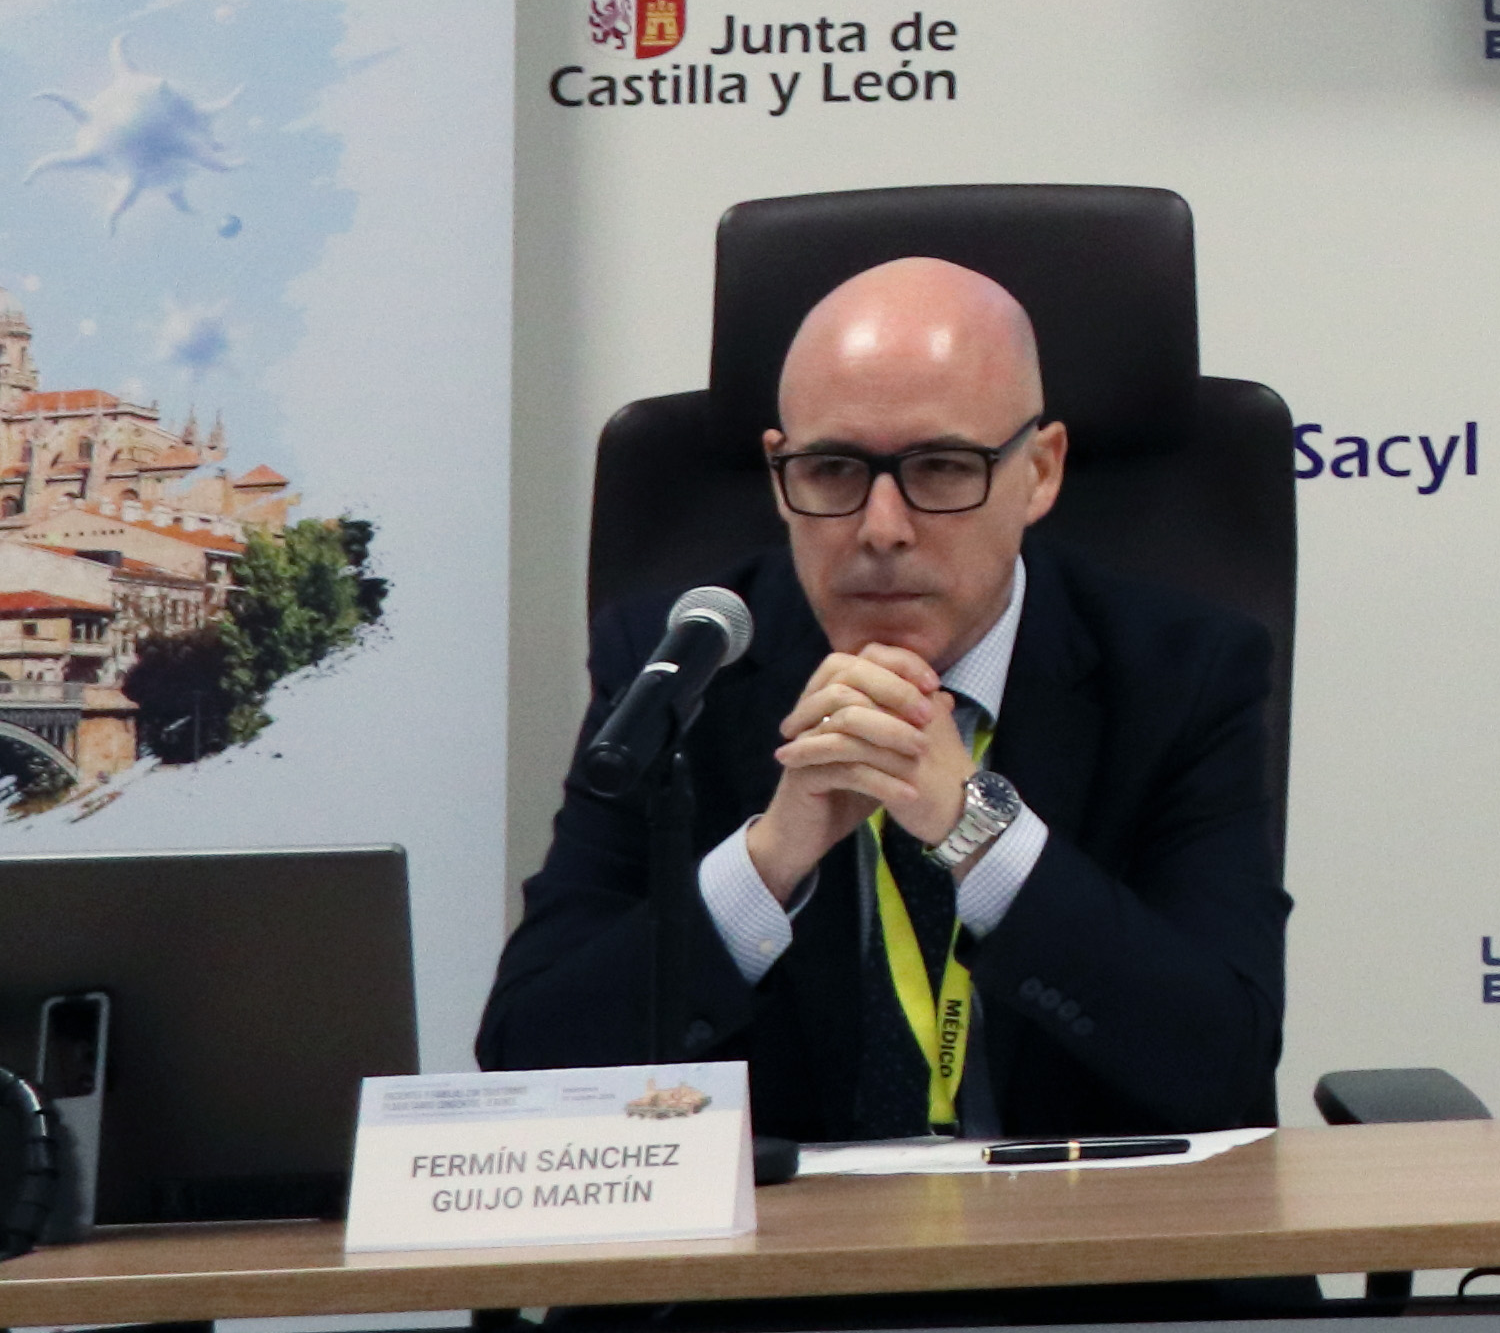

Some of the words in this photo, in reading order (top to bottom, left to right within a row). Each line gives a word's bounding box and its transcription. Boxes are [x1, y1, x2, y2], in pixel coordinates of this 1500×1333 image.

[711, 15, 865, 55] Junta
[891, 12, 956, 52] de
[548, 64, 746, 108] Castilla
[770, 72, 800, 116] y
[823, 60, 956, 102] León
[1293, 421, 1477, 495] Sacyl
[939, 1000, 961, 1078] MÉDICO
[412, 1147, 525, 1178] FERMÍN
[537, 1143, 680, 1172] SÁNCHEZ
[432, 1187, 523, 1212] GUIJO
[534, 1175, 652, 1207] MARTÍN
